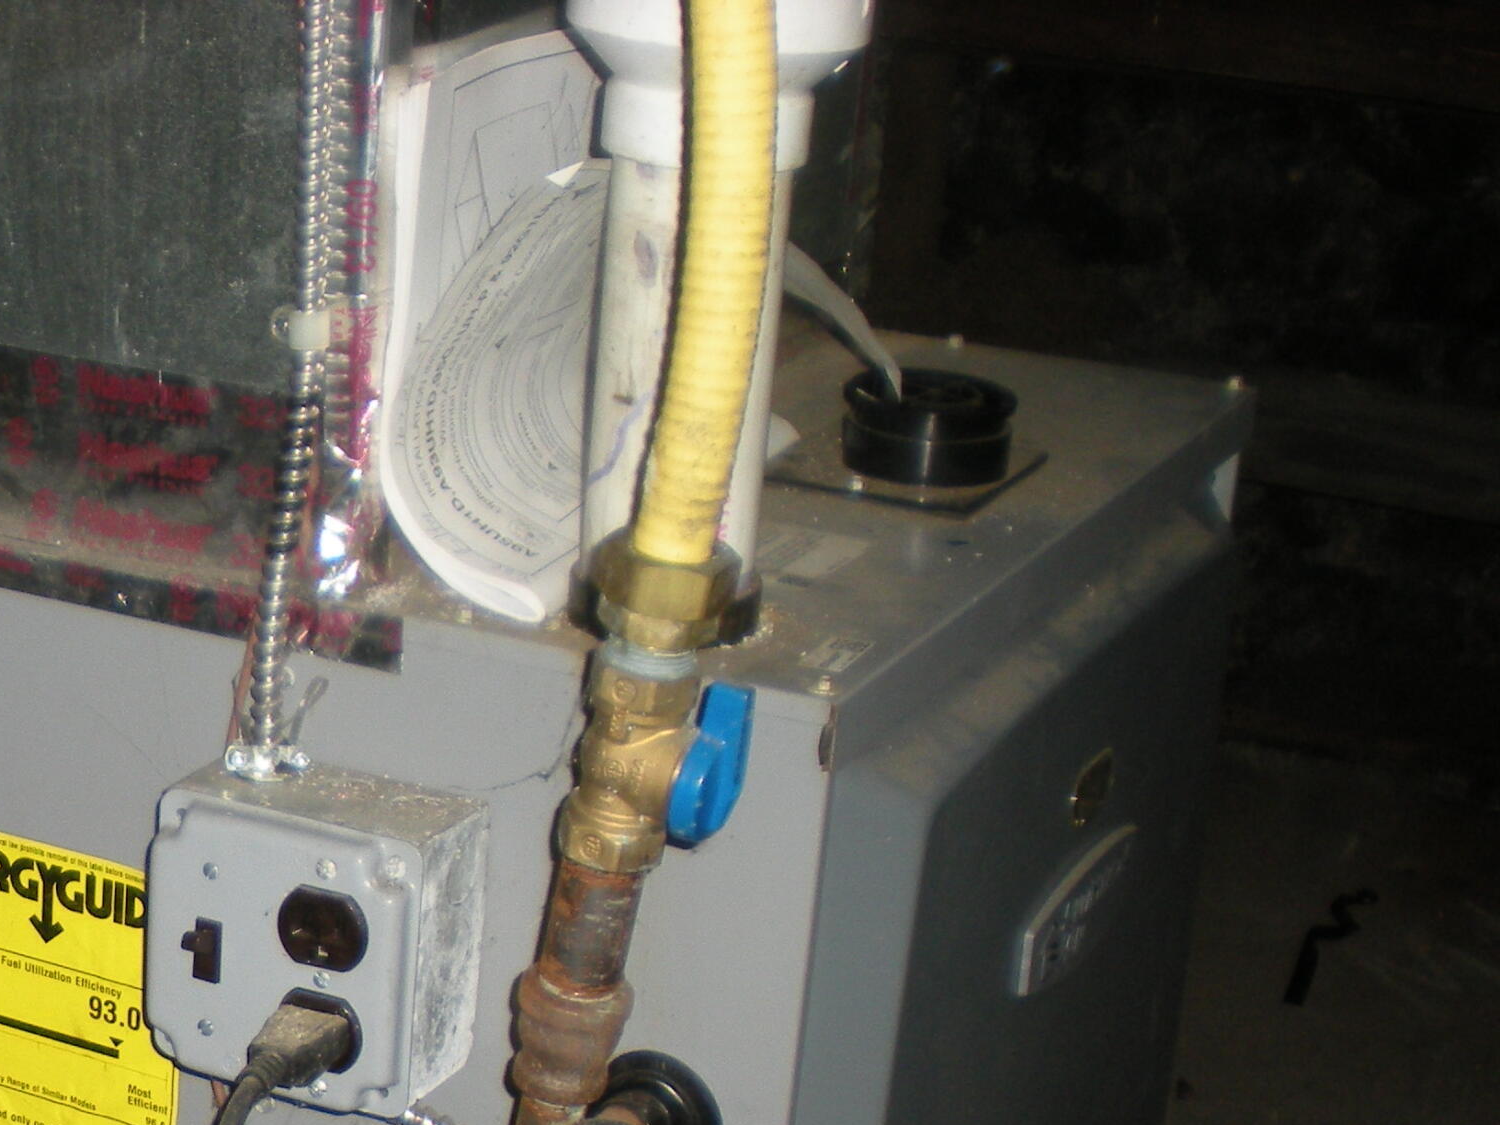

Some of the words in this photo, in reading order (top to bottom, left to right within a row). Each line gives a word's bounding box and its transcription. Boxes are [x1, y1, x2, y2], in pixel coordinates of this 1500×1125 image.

[1, 954, 22, 970] Fuel
[24, 961, 72, 985] Utilization
[75, 976, 122, 1000] Efficiency
[88, 995, 141, 1031] 93.0
[7, 1075, 30, 1091] Range
[42, 1087, 68, 1101] Similar
[70, 1095, 96, 1111] Models
[127, 1096, 168, 1115] Efficient
[128, 1084, 151, 1099] Most
